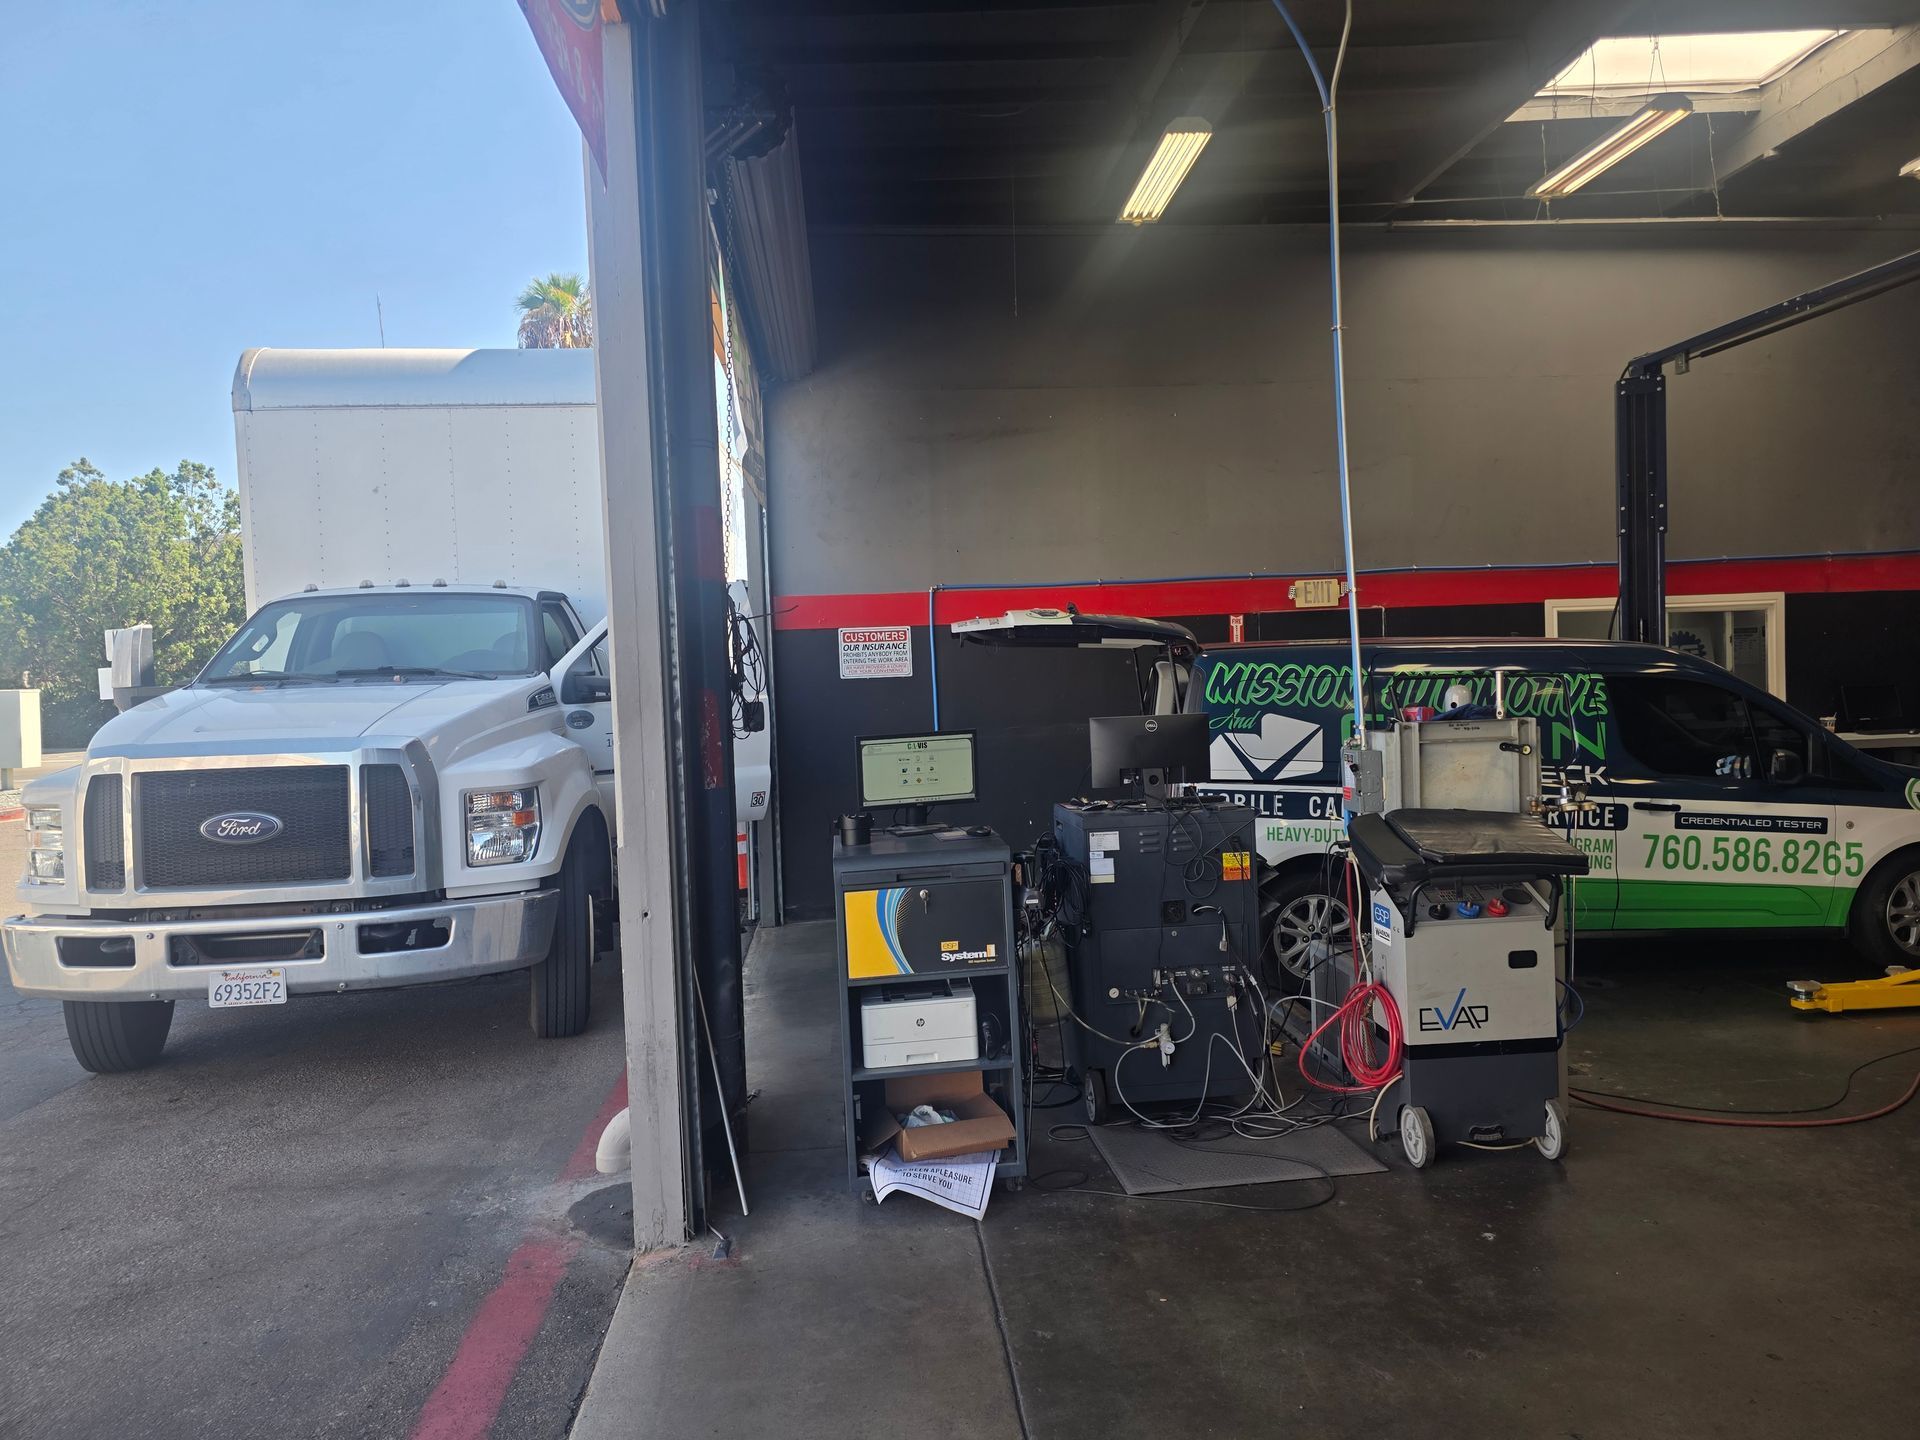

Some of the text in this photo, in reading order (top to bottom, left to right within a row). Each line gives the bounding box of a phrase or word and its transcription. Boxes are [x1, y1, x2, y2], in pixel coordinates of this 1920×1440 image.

[1304, 581, 1332, 603] EXIT
[844, 632, 905, 642] CUSTOMERS
[862, 642, 907, 651] INSURANCE
[1206, 662, 1368, 708] MISSION
[1209, 708, 1261, 730] And
[752, 796, 763, 805] 30
[1198, 792, 1344, 817] BILE CA
[218, 818, 261, 836] Ford
[1681, 816, 1822, 829] CREDENTIALED TESTER
[1643, 834, 1864, 877] 760.586.8265
[224, 972, 269, 983] California
[214, 981, 281, 1001] 69352F2
[1420, 988, 1488, 1031] EVAP
[912, 1173, 937, 1183] SERVE
[938, 1177, 953, 1190] YOU
